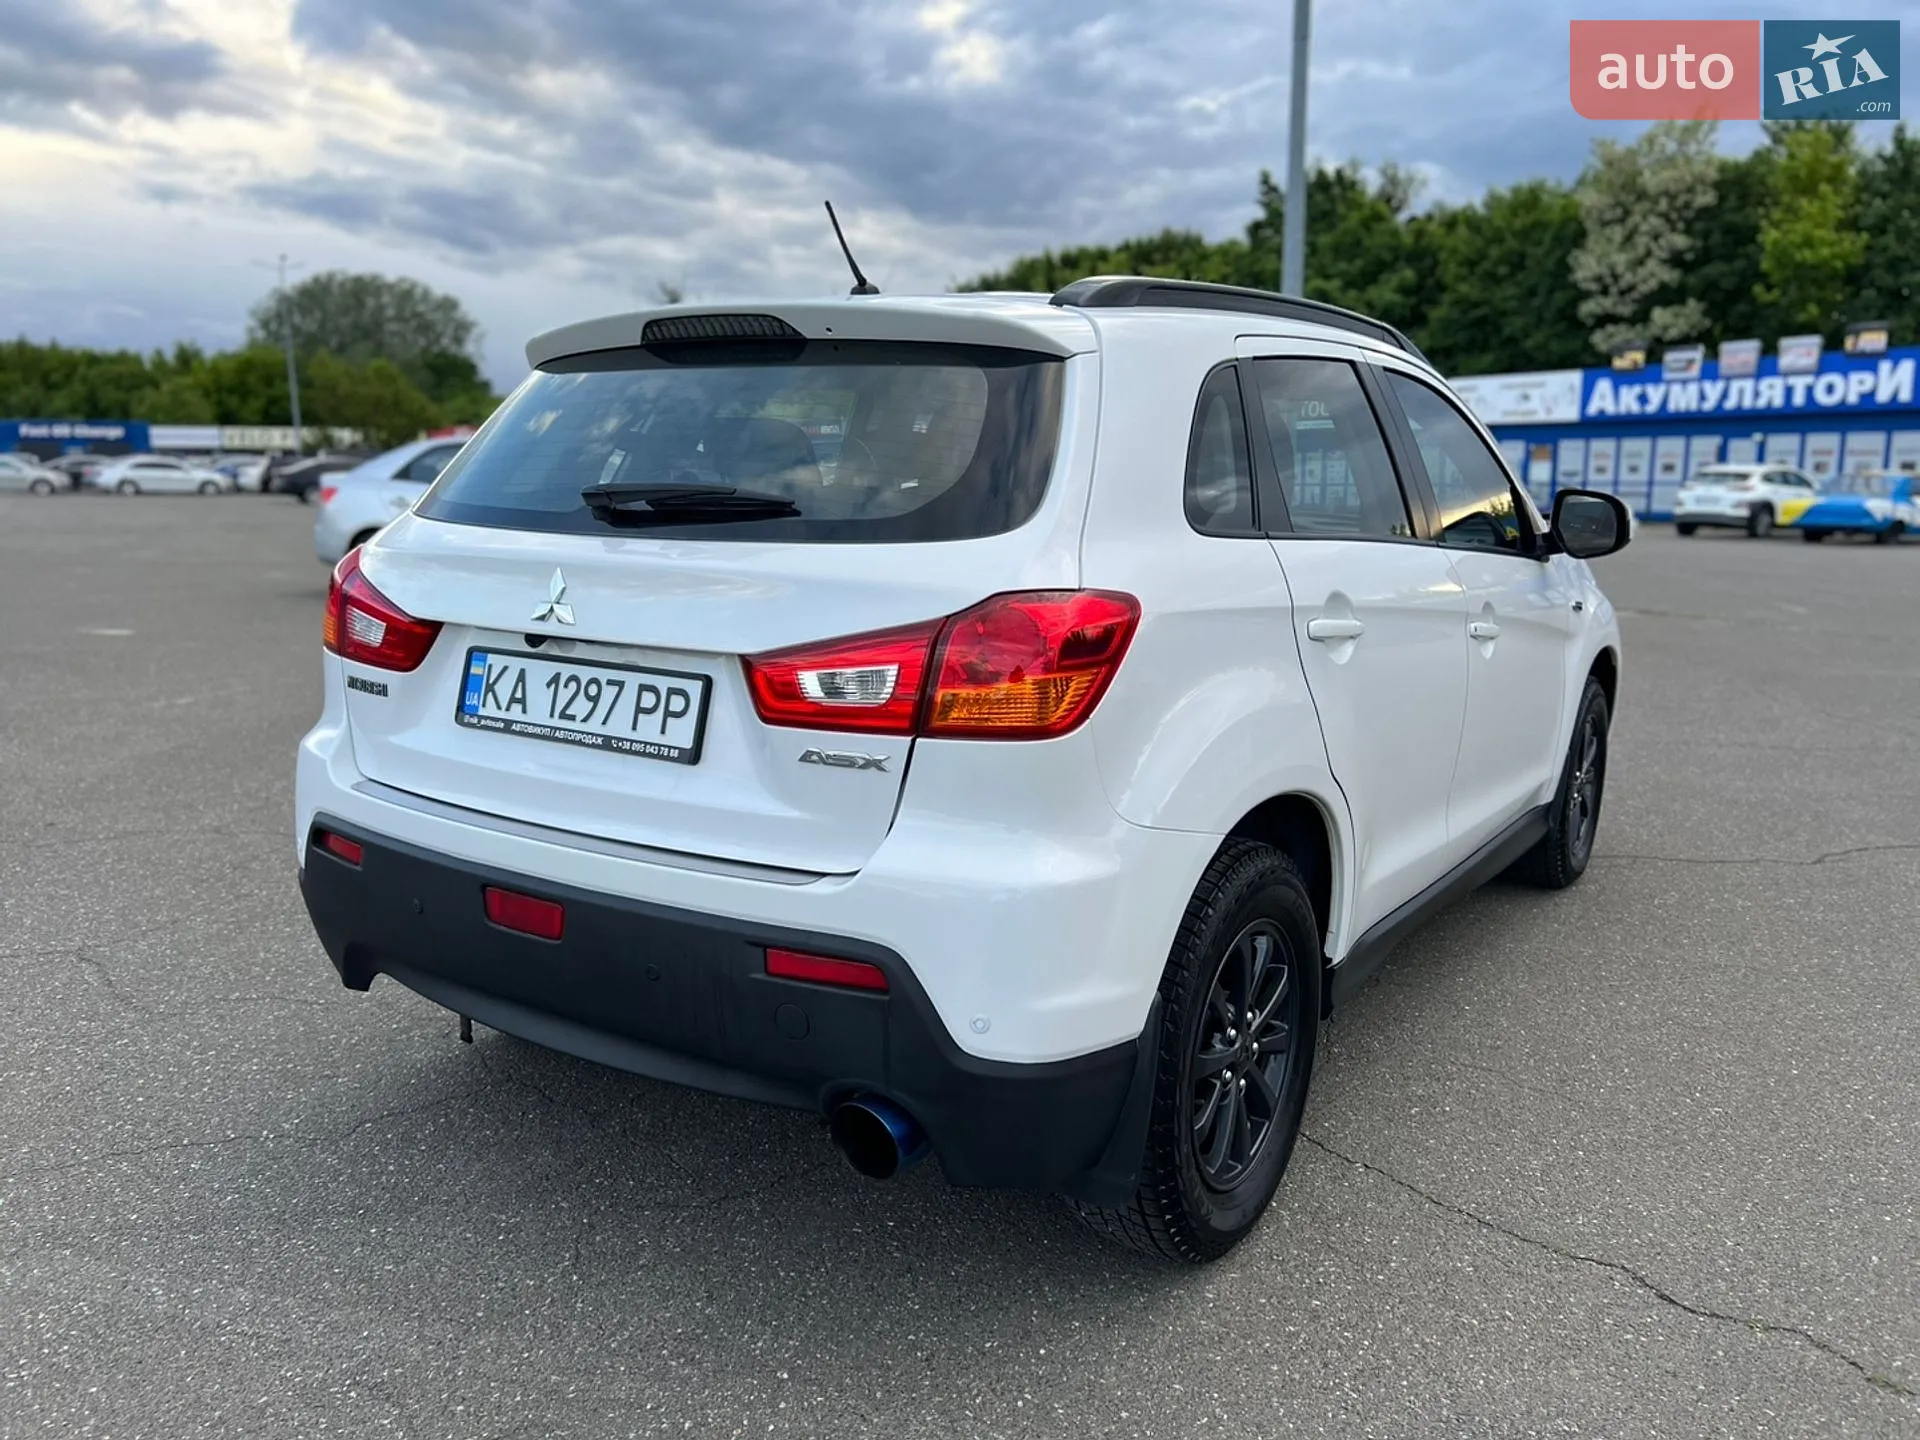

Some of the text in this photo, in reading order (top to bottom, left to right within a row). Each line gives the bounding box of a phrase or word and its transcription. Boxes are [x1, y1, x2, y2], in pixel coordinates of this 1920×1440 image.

[465, 691, 479, 707] UA
[545, 671, 626, 726] 1297
[510, 722, 551, 737] АВТОВИКУП
[554, 729, 604, 745] АВТОПРОДАЖ
[797, 747, 891, 772] ASX
